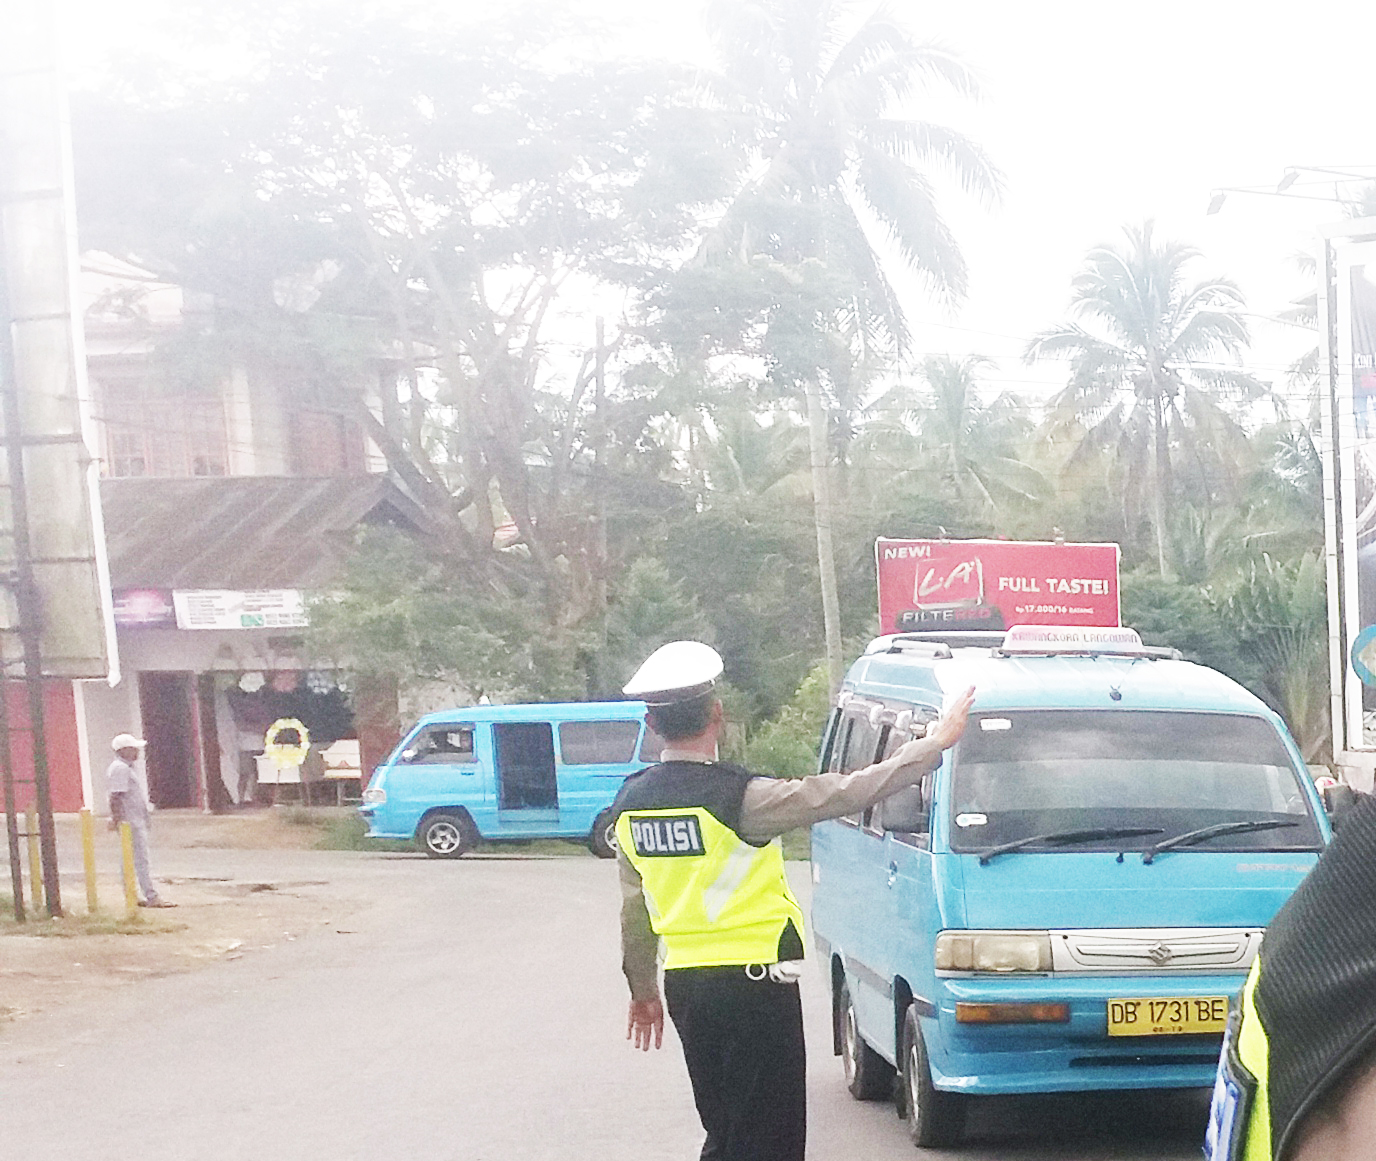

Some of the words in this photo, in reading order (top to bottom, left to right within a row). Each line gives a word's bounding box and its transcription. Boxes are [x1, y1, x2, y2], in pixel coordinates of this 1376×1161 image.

[1354, 352, 1373, 368] KINI
[884, 545, 931, 560] NEW!
[998, 576, 1040, 593] FULL
[1046, 578, 1109, 595] TASTE!
[630, 820, 700, 852] POLISI
[1111, 1001, 1137, 1024] DB
[1148, 1000, 1189, 1023] 1731
[1196, 999, 1224, 1022] BE
